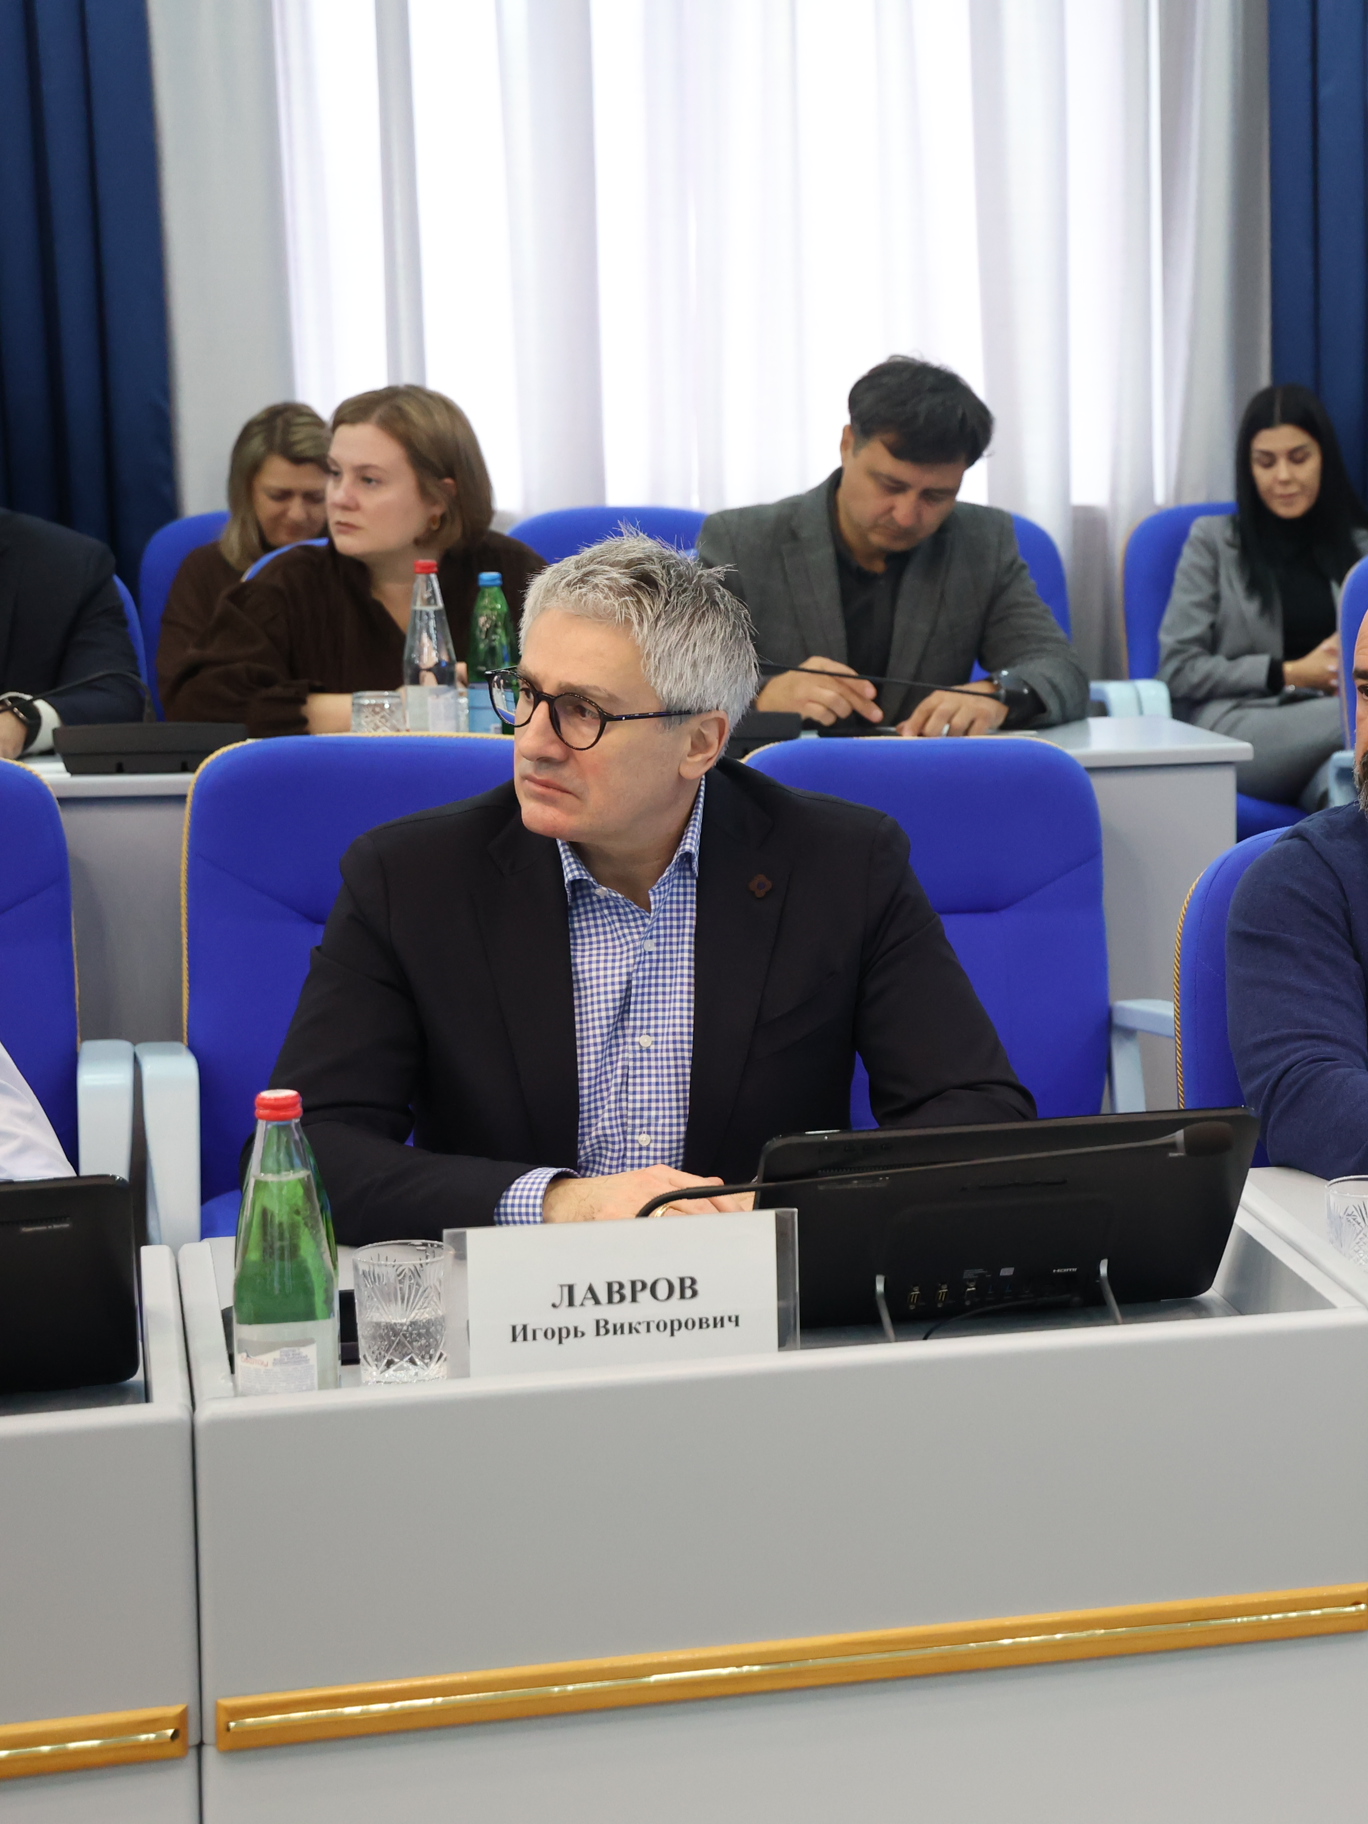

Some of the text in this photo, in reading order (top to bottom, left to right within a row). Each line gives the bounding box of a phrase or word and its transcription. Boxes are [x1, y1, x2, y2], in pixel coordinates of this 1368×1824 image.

[551, 1275, 700, 1309] ЛАВРОВ
[510, 1314, 741, 1345] Игорь Викторович
